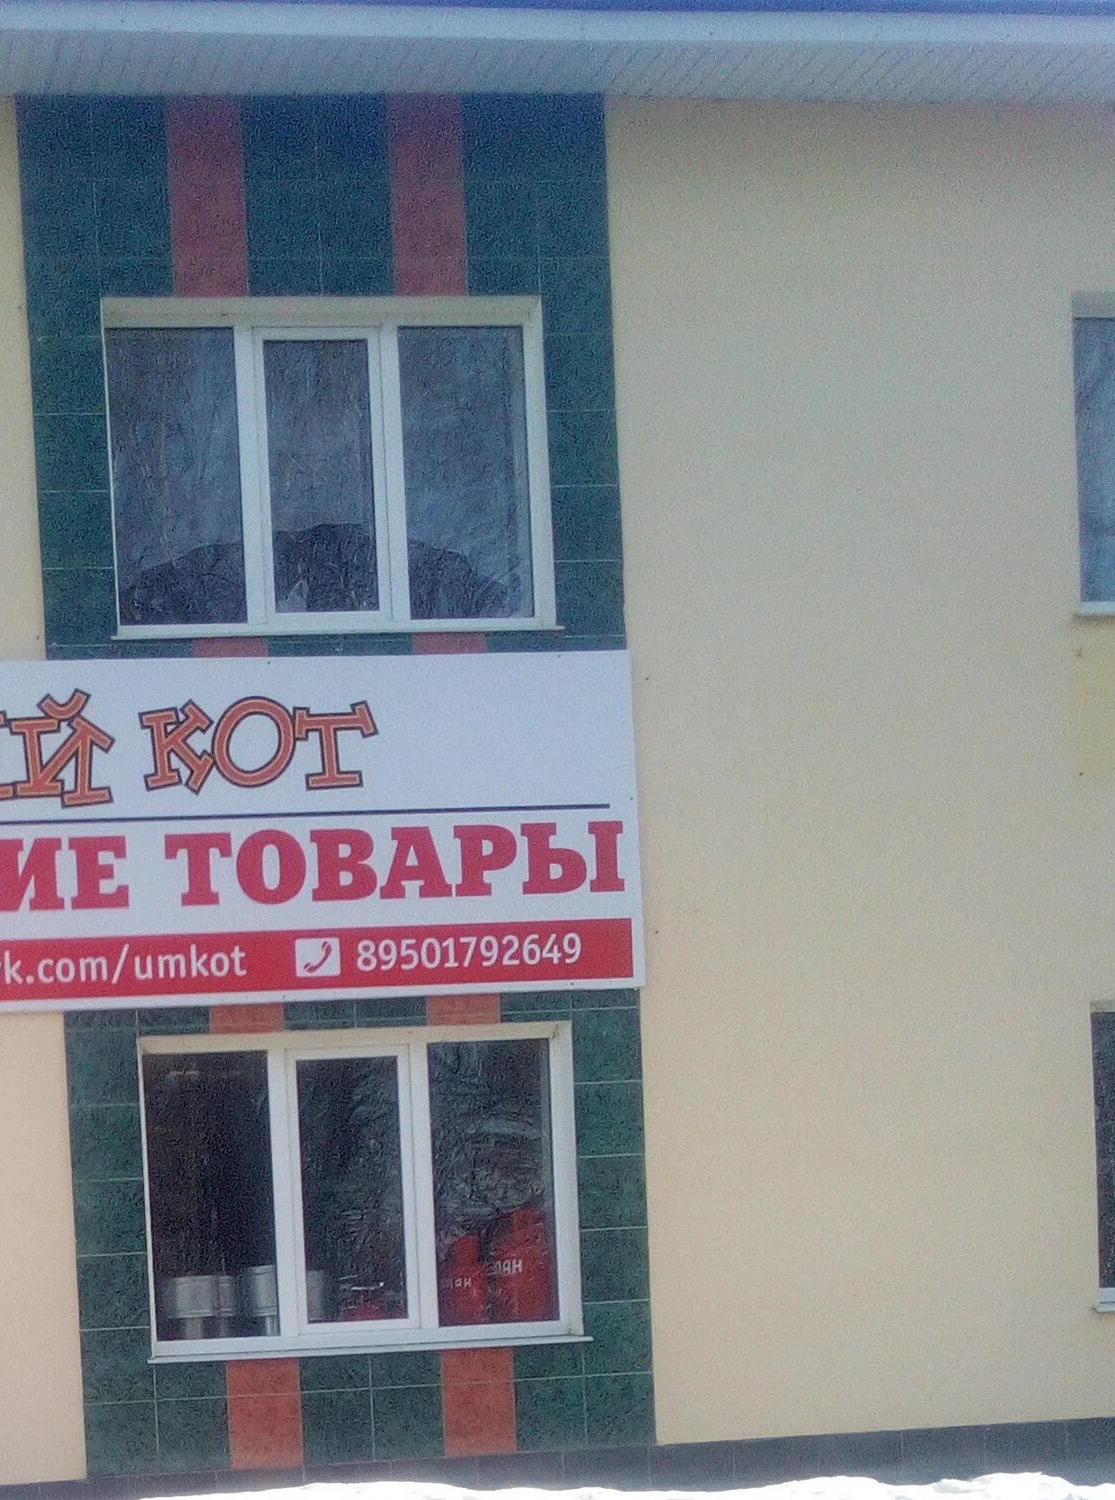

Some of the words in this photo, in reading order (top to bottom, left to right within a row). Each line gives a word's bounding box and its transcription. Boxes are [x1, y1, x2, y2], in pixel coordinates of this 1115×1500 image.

[139, 695, 379, 793] КОТ
[164, 821, 625, 906] ТОВАРЫ
[356, 931, 584, 971] 89501792649
